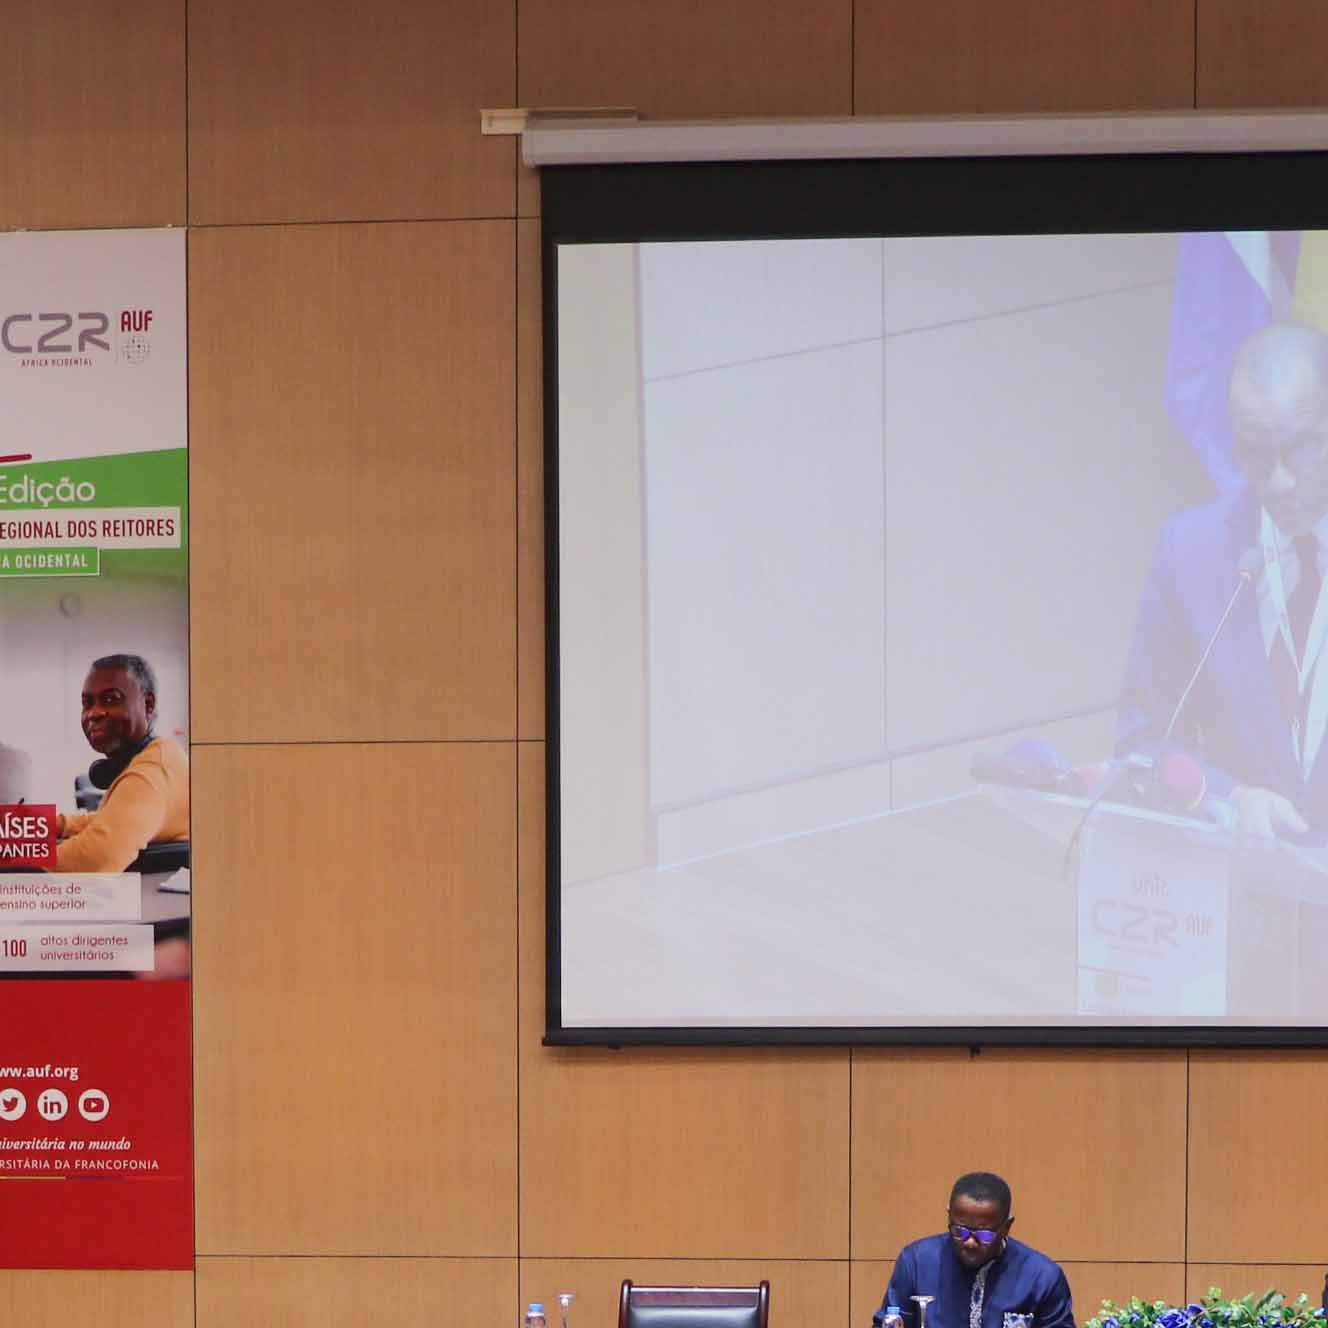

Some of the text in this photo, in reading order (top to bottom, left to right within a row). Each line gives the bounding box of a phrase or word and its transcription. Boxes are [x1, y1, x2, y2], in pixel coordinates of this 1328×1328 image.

[121, 310, 153, 332] AUF
[67, 520, 98, 539] DOS
[102, 518, 175, 538] REITORES
[15, 553, 88, 569] OCIDENTAL
[65, 883, 82, 895] de
[0, 899, 86, 912] ensino superior
[40, 934, 129, 949] altos dirigentes
[40, 948, 114, 961] universitários
[69, 1139, 85, 1151] no
[88, 1136, 131, 1151] mundo
[54, 1159, 70, 1169] DA
[74, 1159, 160, 1170] FRANCOFONIA
